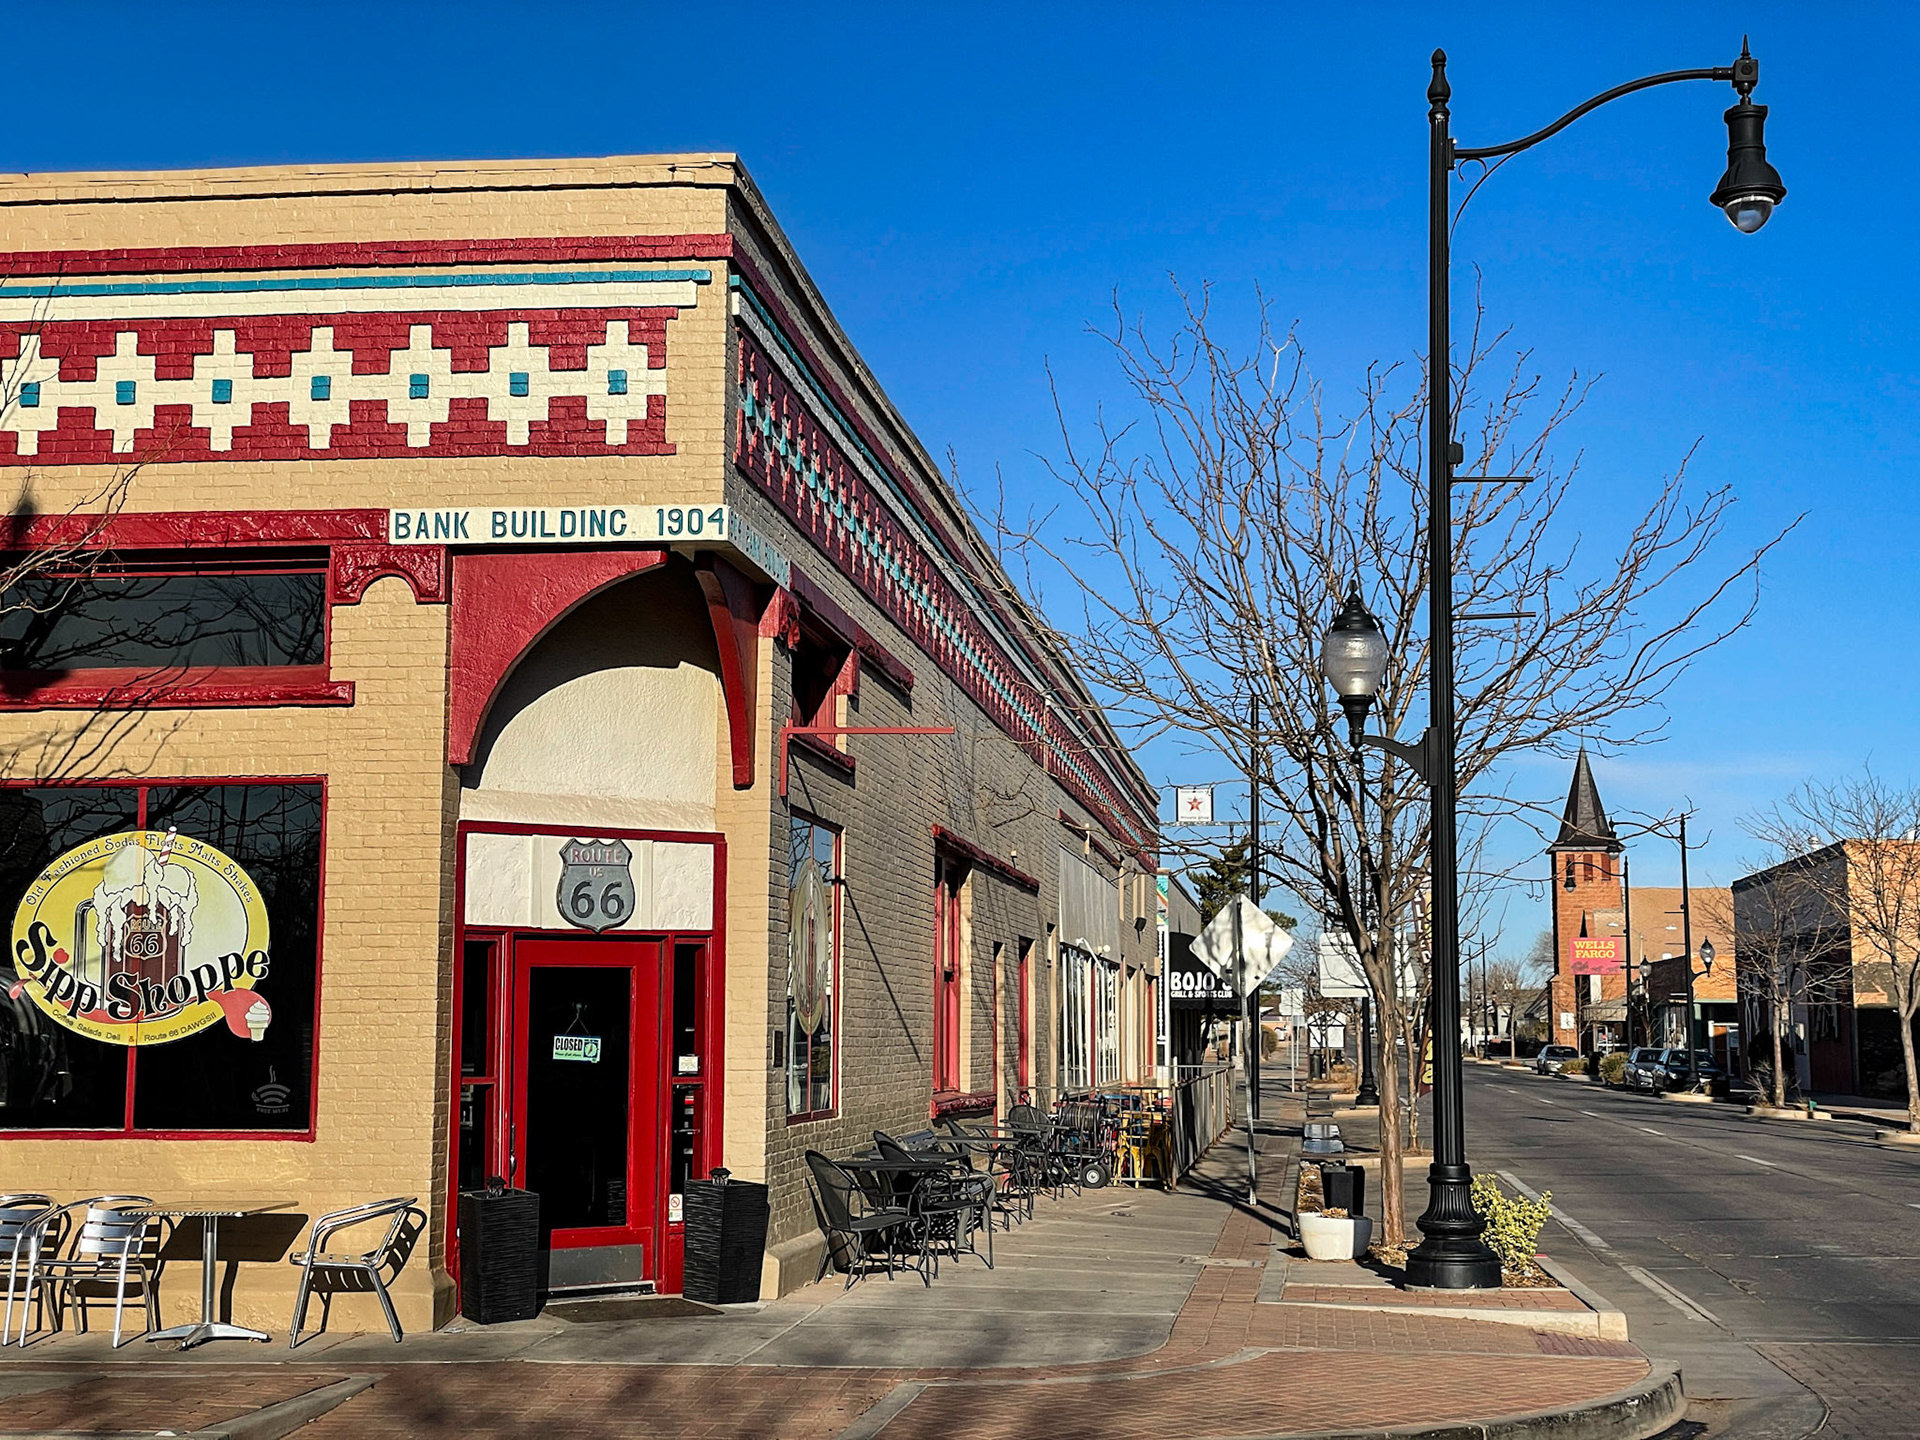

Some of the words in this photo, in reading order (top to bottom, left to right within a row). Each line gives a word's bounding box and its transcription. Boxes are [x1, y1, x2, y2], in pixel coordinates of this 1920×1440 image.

[394, 511, 470, 540] BANK
[491, 509, 628, 539] BUILDING
[656, 507, 724, 537] 1904
[570, 848, 623, 864] ROUTE
[25, 885, 45, 906] Old
[40, 844, 101, 882] Fashioned
[104, 837, 141, 851] Sodas
[144, 833, 184, 851] Floats
[188, 841, 222, 867] Malts
[223, 863, 255, 904] Shakes
[589, 866, 605, 878] US
[570, 880, 625, 920] 66
[130, 933, 159, 956] 66
[1573, 940, 1616, 950] WELLS
[1575, 949, 1616, 959] FARGO
[16, 920, 98, 1020] Sipp
[107, 950, 270, 1021] Shoppe
[1188, 990, 1194, 998] &
[1194, 990, 1217, 998] SPORTS
[1217, 990, 1233, 998] CLUB
[51, 1008, 74, 1026] Coffee
[144, 1033, 167, 1042] Route
[555, 1037, 583, 1052] CLOSED
